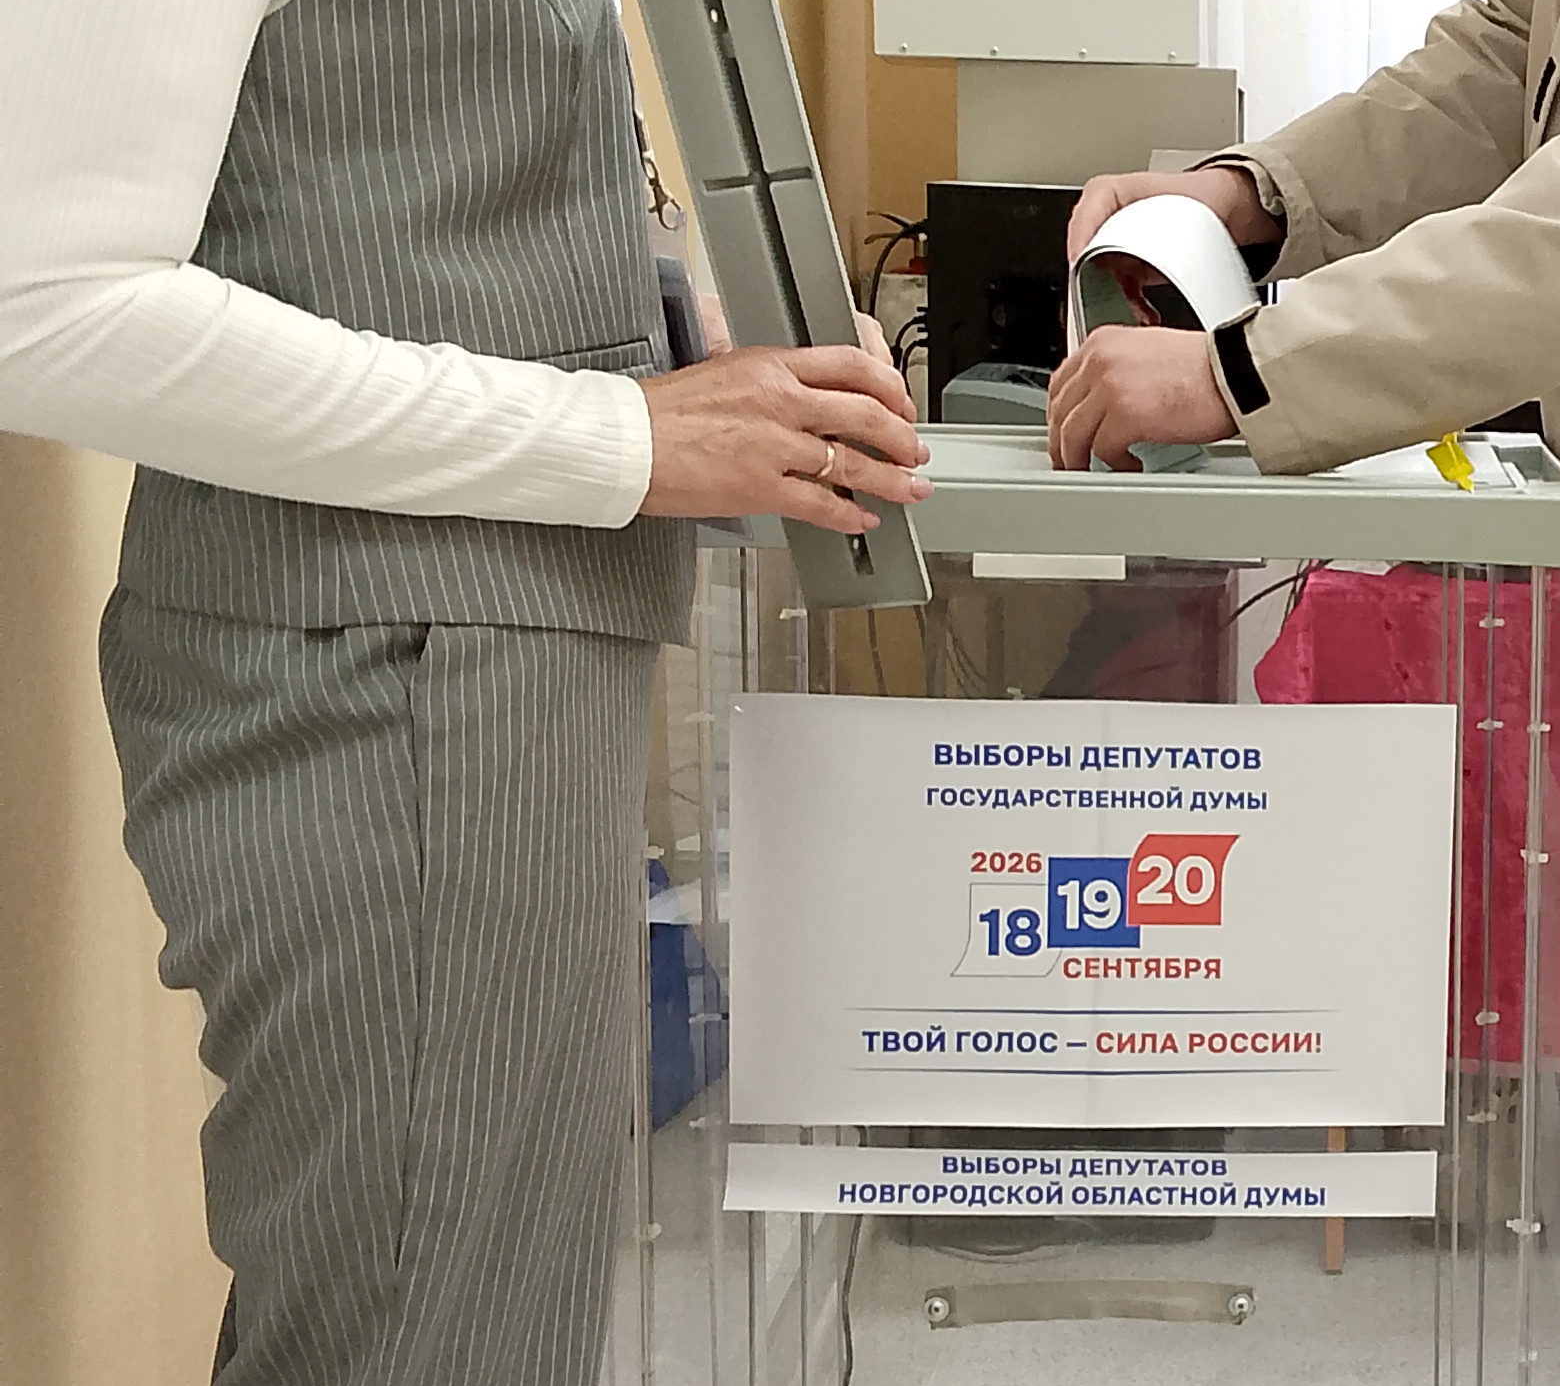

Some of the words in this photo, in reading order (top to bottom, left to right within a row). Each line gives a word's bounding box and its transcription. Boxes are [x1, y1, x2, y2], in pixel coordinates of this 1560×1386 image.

[933, 743, 1072, 768] ВЫБОРЫ
[1079, 746, 1263, 771] ДЕПУТАТОВ
[926, 786, 1183, 809] ГОСУДАРСТВЕННОЙ
[1189, 791, 1268, 812] ДУМЫ
[970, 851, 1043, 874] 2026
[978, 908, 1042, 957] 18
[1056, 878, 1122, 930] 19
[1136, 854, 1216, 906] 20
[1063, 957, 1222, 980] СЕНТЯБРЯ
[861, 1024, 947, 1053] ТВОЙ
[955, 1030, 1058, 1053] ГОЛОС
[1095, 1031, 1179, 1055] СИЛА
[1188, 1032, 1322, 1054] РОССИИ!
[941, 1156, 1062, 1176] ВЫБОРЫ
[1068, 1158, 1228, 1179] ДЕПУТАТОВ
[838, 1180, 1064, 1207] НОВГОРОДСКОЙ
[1071, 1182, 1238, 1206] ОБЛАСТНОЙ
[1243, 1186, 1326, 1210] ДУМЫ
